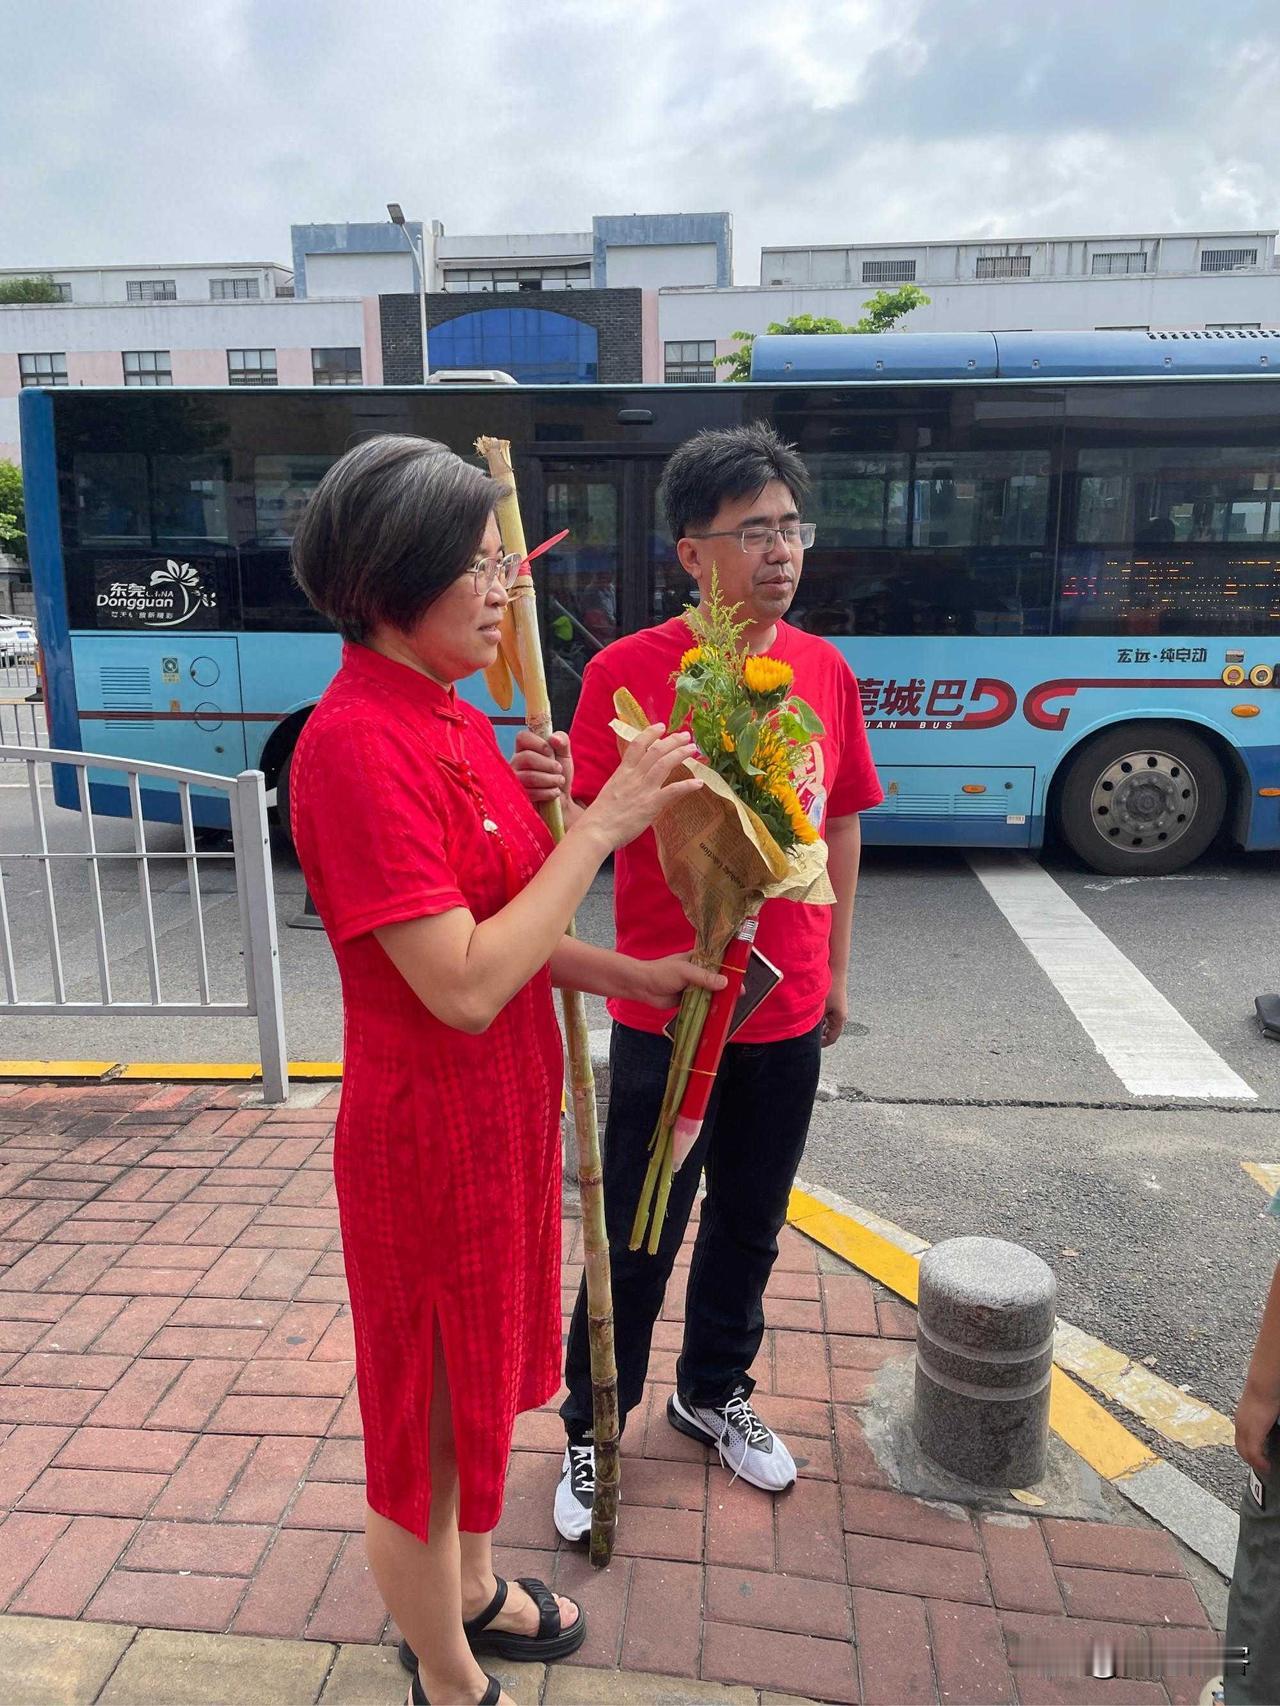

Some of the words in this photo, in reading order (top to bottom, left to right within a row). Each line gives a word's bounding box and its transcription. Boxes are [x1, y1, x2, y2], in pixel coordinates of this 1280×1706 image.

[110, 582, 146, 597] 东莞
[97, 594, 174, 610] Dongguan
[919, 721, 953, 729] BUS
